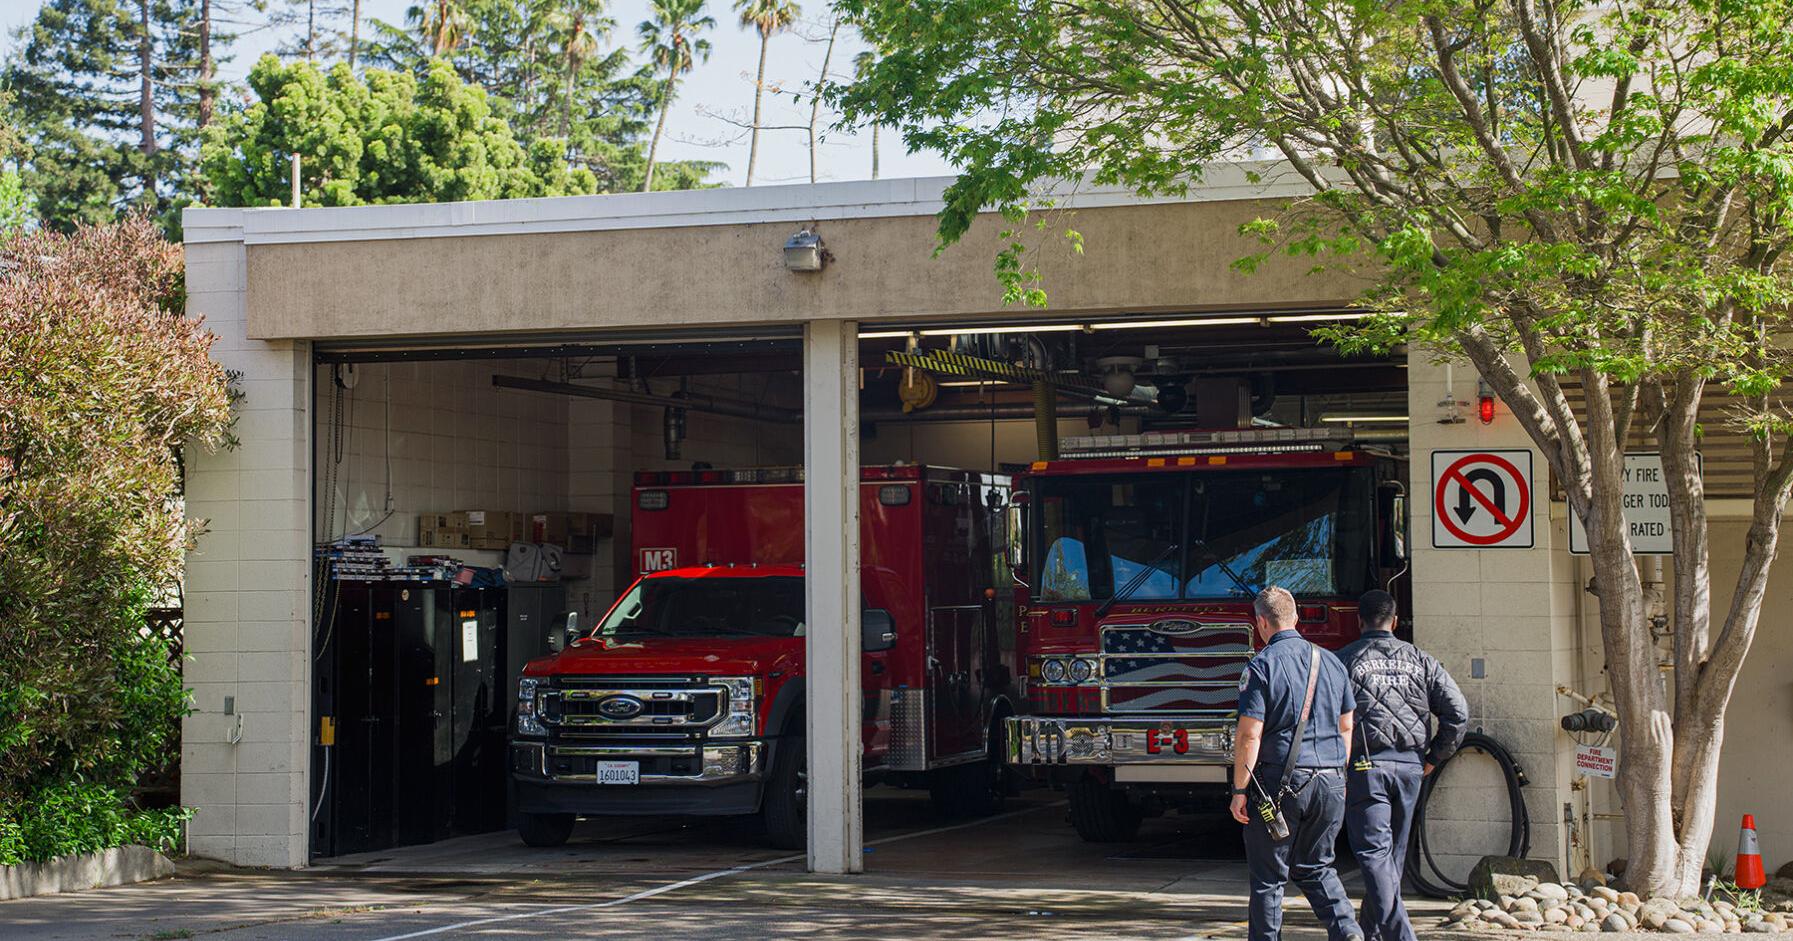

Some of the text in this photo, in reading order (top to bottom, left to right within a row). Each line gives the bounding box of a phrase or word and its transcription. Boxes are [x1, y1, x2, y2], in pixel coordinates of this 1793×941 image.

[1636, 468, 1659, 482] FIRE
[1649, 494, 1670, 508] TOD
[1631, 522, 1664, 536] RATED
[645, 551, 673, 570] M3
[1355, 659, 1423, 676] BERKELEY
[1371, 673, 1409, 686] FIRE
[1147, 728, 1189, 754] E-3
[1577, 753, 1614, 765] DEPARTMENT
[1589, 748, 1601, 756] FIRE
[1577, 761, 1613, 771] CONNECTION
[600, 769, 636, 781] 1601043
